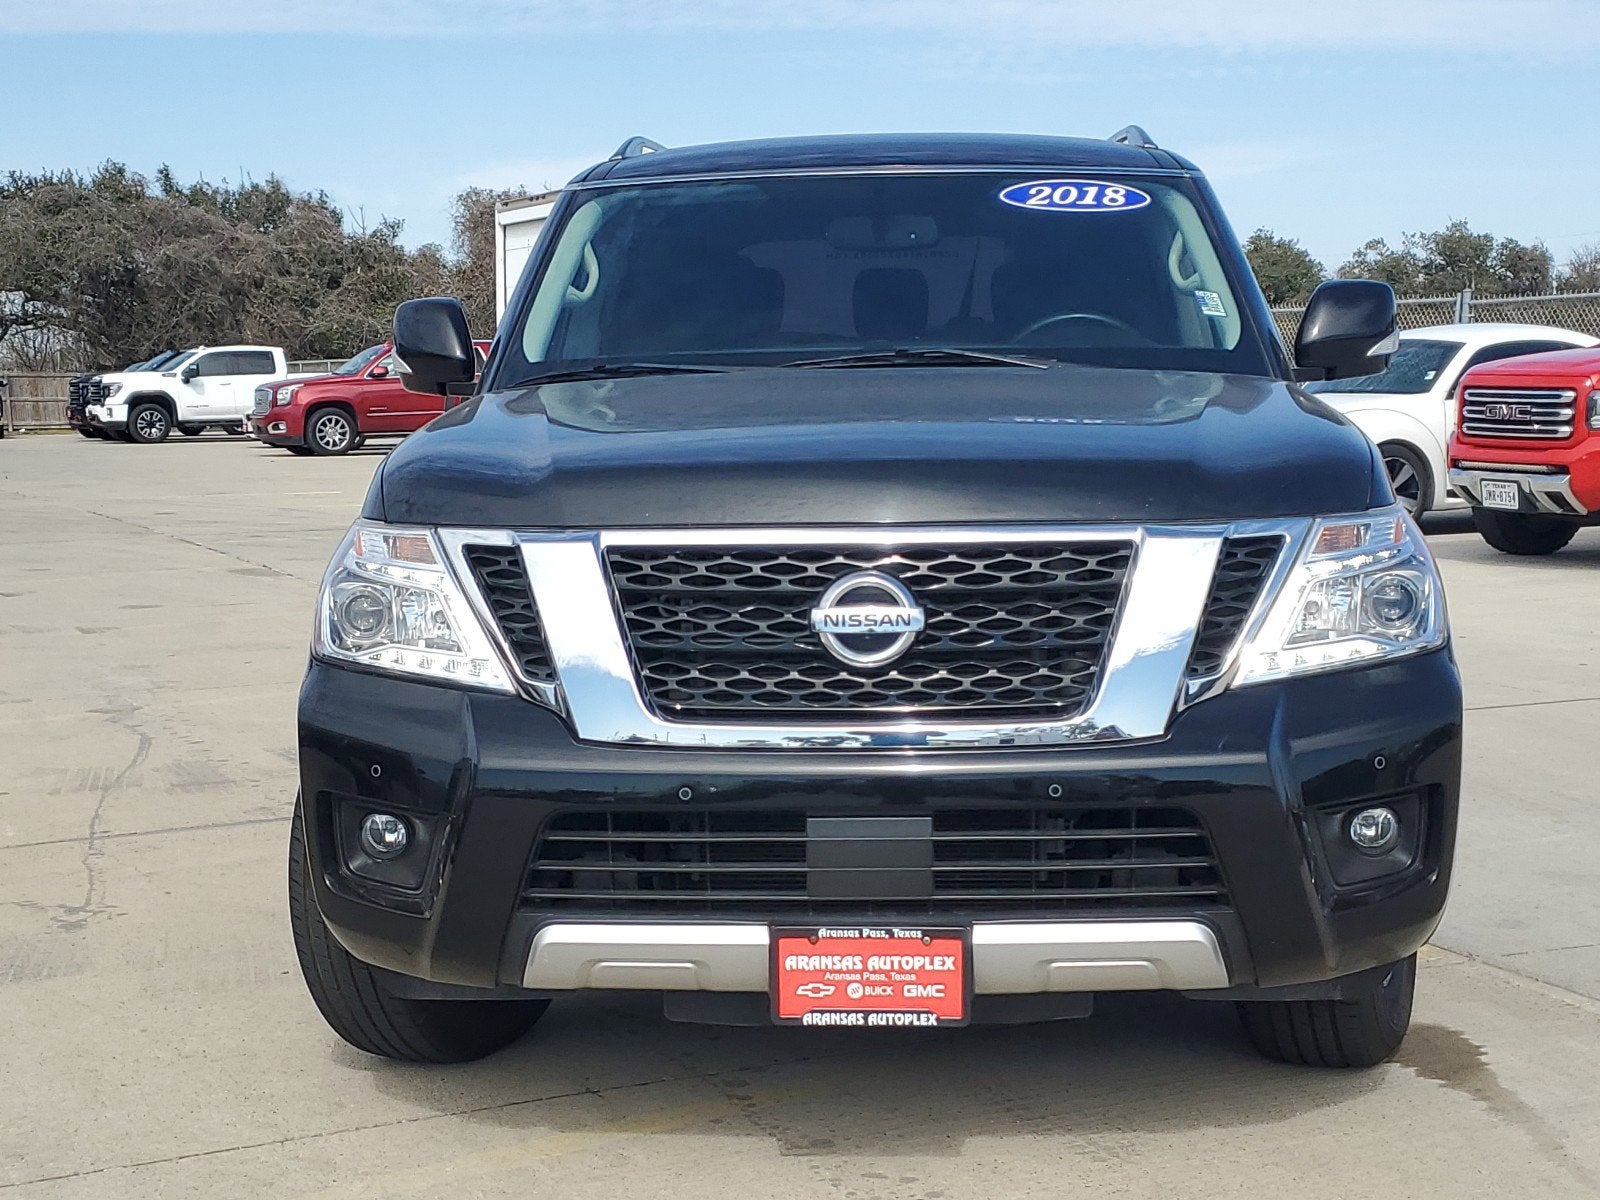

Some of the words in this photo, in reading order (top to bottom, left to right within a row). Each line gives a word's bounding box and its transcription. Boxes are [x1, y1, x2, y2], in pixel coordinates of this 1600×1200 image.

[1025, 186, 1126, 206] 2018
[1484, 405, 1531, 420] GMC
[824, 613, 911, 627] NISSAN
[818, 928, 860, 938] Aransas
[863, 928, 889, 939] Pass,
[892, 929, 922, 938] Texas
[785, 955, 863, 970] ARANSAS
[867, 955, 955, 970] AUTOPLEX
[824, 972, 861, 981] Aransas
[864, 972, 888, 982] Pass,
[890, 972, 916, 981] Texas
[864, 986, 893, 996] BUICK
[903, 984, 945, 997] GMC
[802, 1012, 864, 1025] ARANSAS
[868, 1012, 937, 1025] AUTOPLEX
